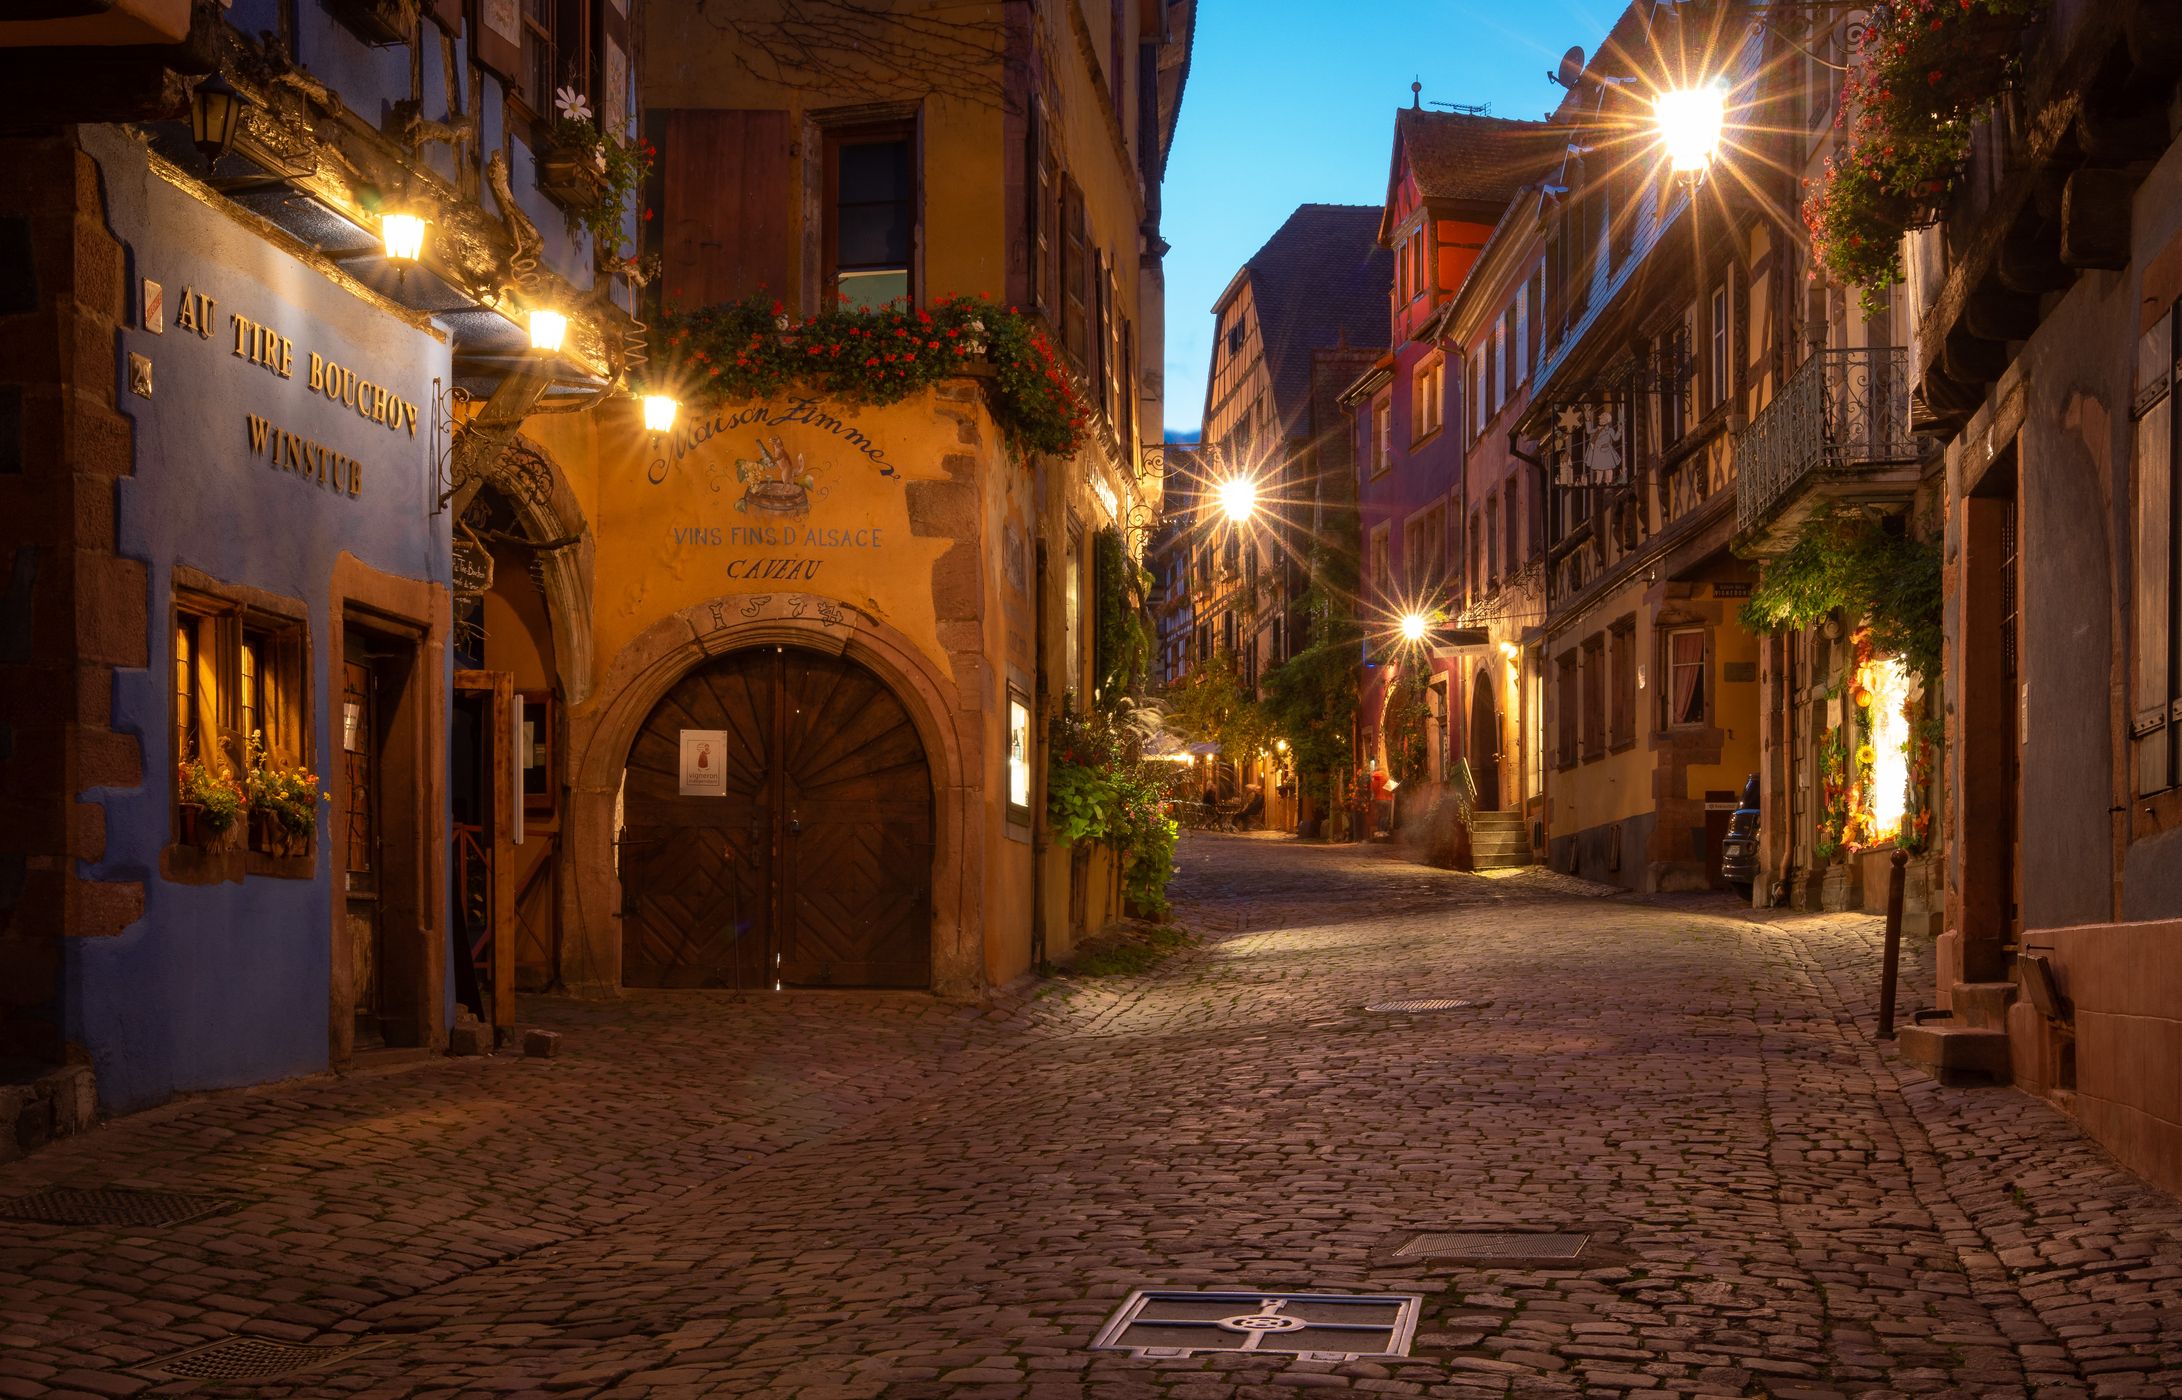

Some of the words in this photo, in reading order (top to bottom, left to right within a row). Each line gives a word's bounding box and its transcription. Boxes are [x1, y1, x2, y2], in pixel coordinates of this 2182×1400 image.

[177, 284, 218, 338] AU
[232, 312, 293, 378] TIRE
[308, 351, 418, 441] BOUCHON
[248, 412, 362, 496] WINSTUB
[648, 407, 769, 485] Maison
[766, 397, 901, 480] Zimmer
[674, 527, 722, 546] VINS
[731, 527, 777, 546] FINS
[727, 559, 824, 581] CAVEAU
[688, 772, 718, 780] vigneron
